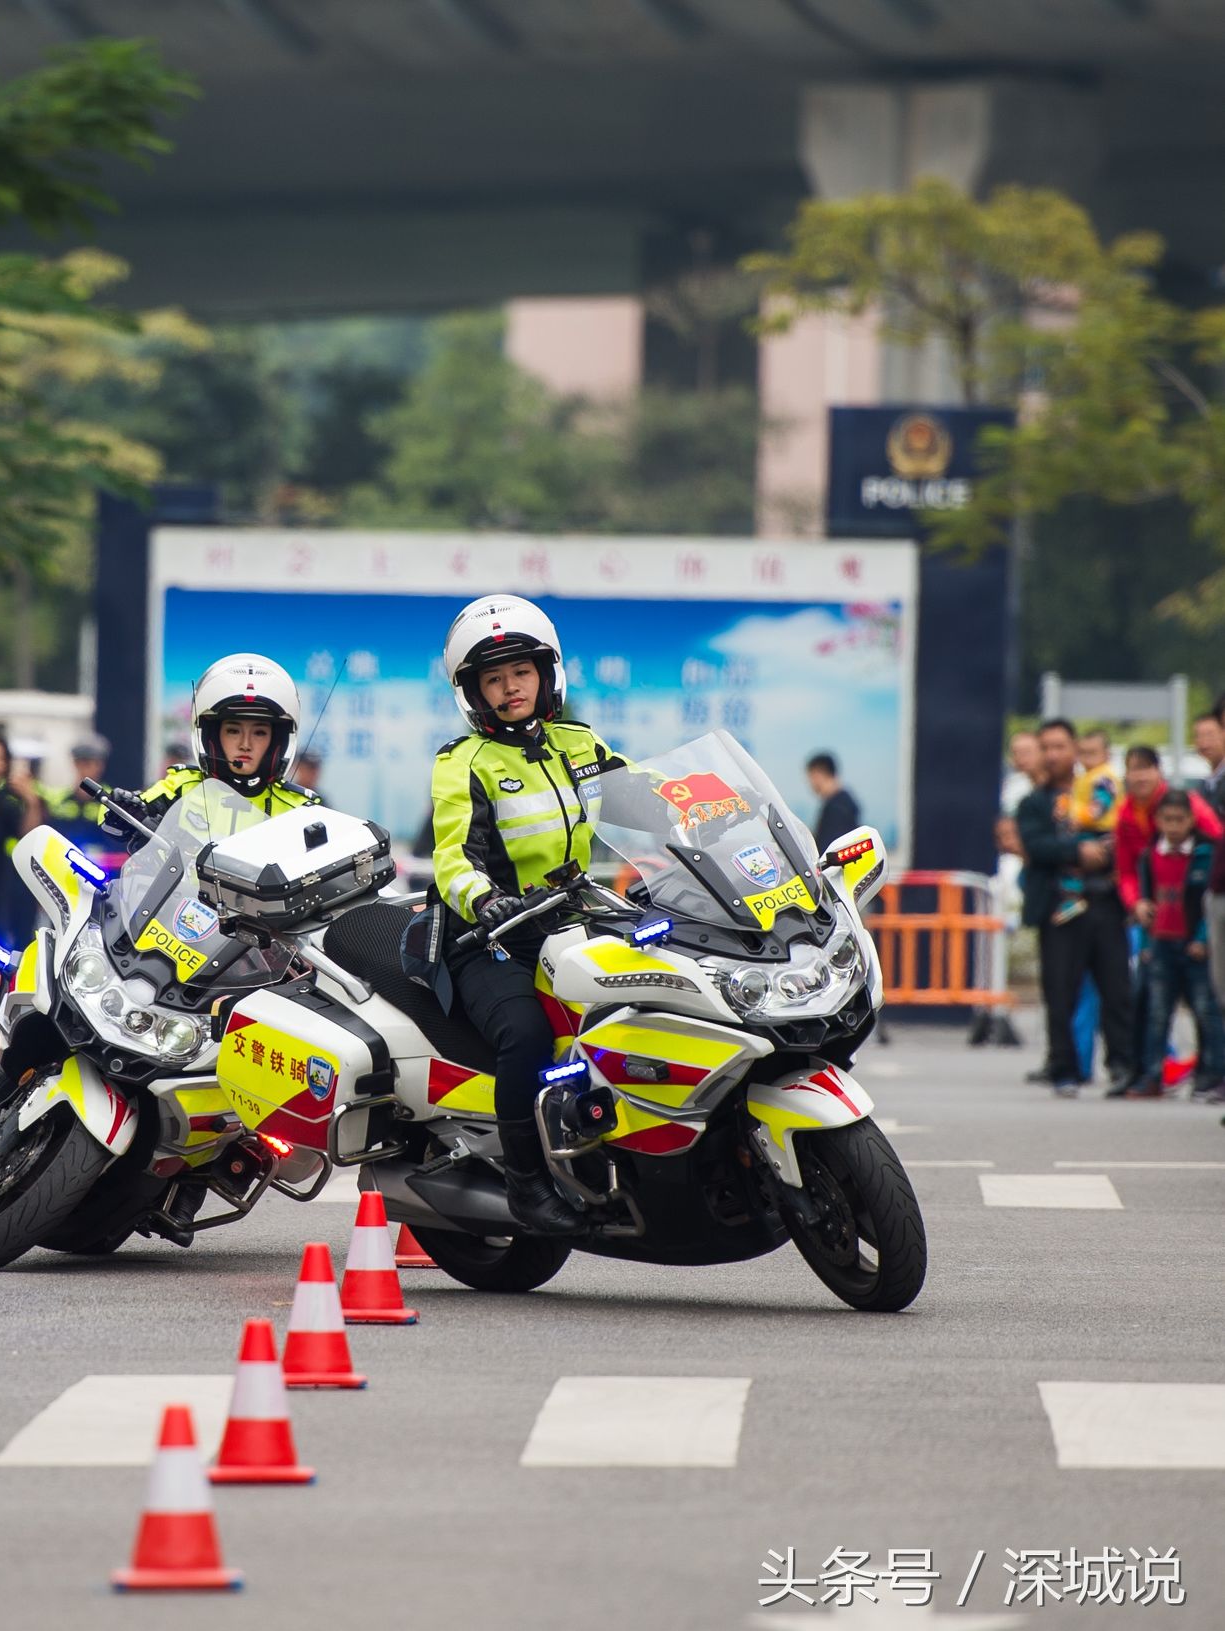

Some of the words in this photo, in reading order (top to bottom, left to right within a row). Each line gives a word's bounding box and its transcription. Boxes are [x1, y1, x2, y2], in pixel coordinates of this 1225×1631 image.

[860, 475, 971, 510] POLICE
[584, 764, 600, 776] 6151
[752, 883, 807, 916] POLICE
[145, 925, 201, 970] POLICE
[233, 1031, 308, 1085] 交警铁骑
[230, 1088, 261, 1116] 71-39
